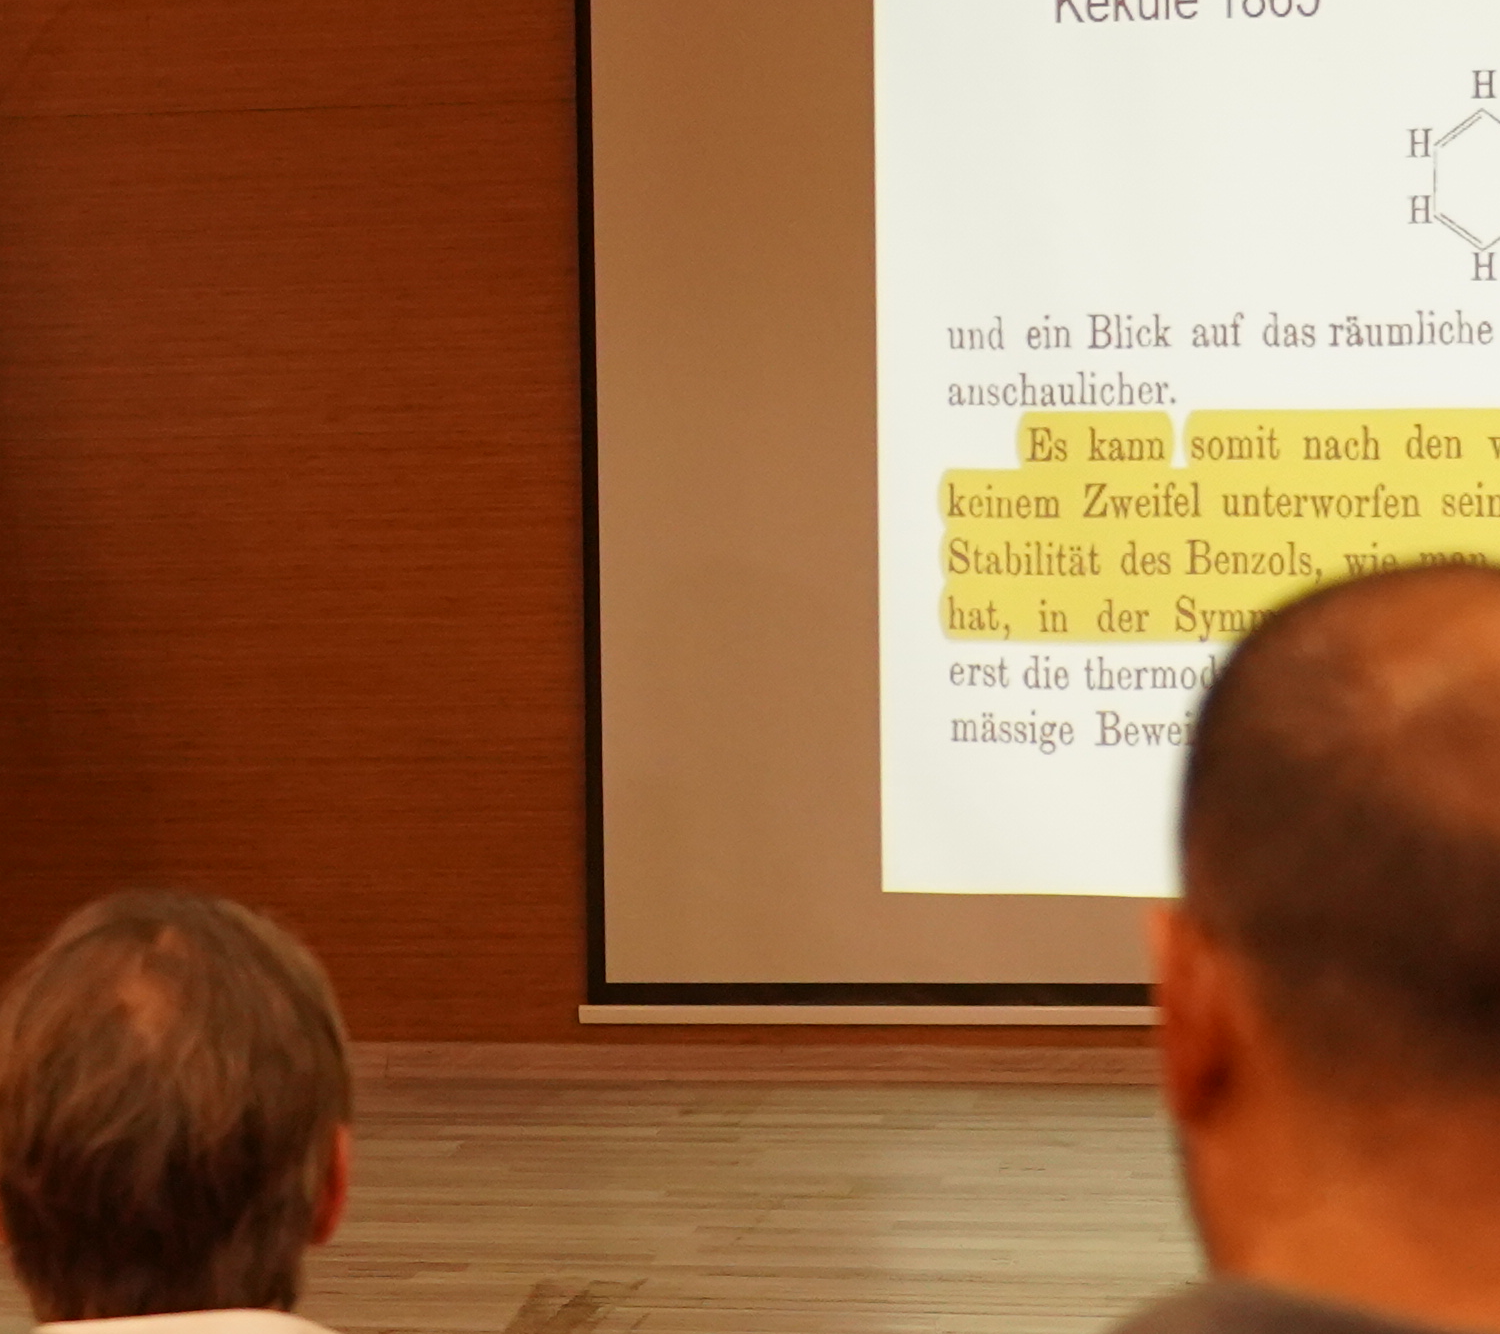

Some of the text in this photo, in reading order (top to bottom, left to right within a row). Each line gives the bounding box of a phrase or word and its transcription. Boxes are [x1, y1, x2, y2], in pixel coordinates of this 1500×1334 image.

[1471, 69, 1497, 100] H
[1407, 128, 1433, 158] H
[1408, 195, 1433, 224] H
[1470, 252, 1498, 282] H
[946, 315, 1005, 351] und
[1025, 314, 1072, 351] ein
[1087, 313, 1172, 350] Blick
[1191, 311, 1245, 349] auf
[1261, 311, 1317, 348] das
[1328, 309, 1494, 348] räumliche
[947, 370, 1177, 408] anschaulicher.
[1024, 425, 1068, 463] Es
[1087, 425, 1166, 462] kann
[1190, 423, 1281, 461] somit
[1302, 423, 1381, 461] nach
[1405, 422, 1464, 460] den
[945, 479, 1061, 520] keinem
[1082, 480, 1202, 520] Zweifel
[1221, 482, 1422, 520] unterworfen
[946, 536, 1102, 577] Stabilität
[1120, 539, 1172, 577] des
[1184, 538, 1329, 585] Benzols,
[946, 593, 1013, 642] hat,
[1037, 598, 1073, 637] in
[1096, 598, 1151, 638] der
[949, 656, 1010, 689] erst
[1022, 654, 1070, 691] die
[1084, 654, 1218, 691] thermod
[950, 709, 1195, 756] mässige Bewei
